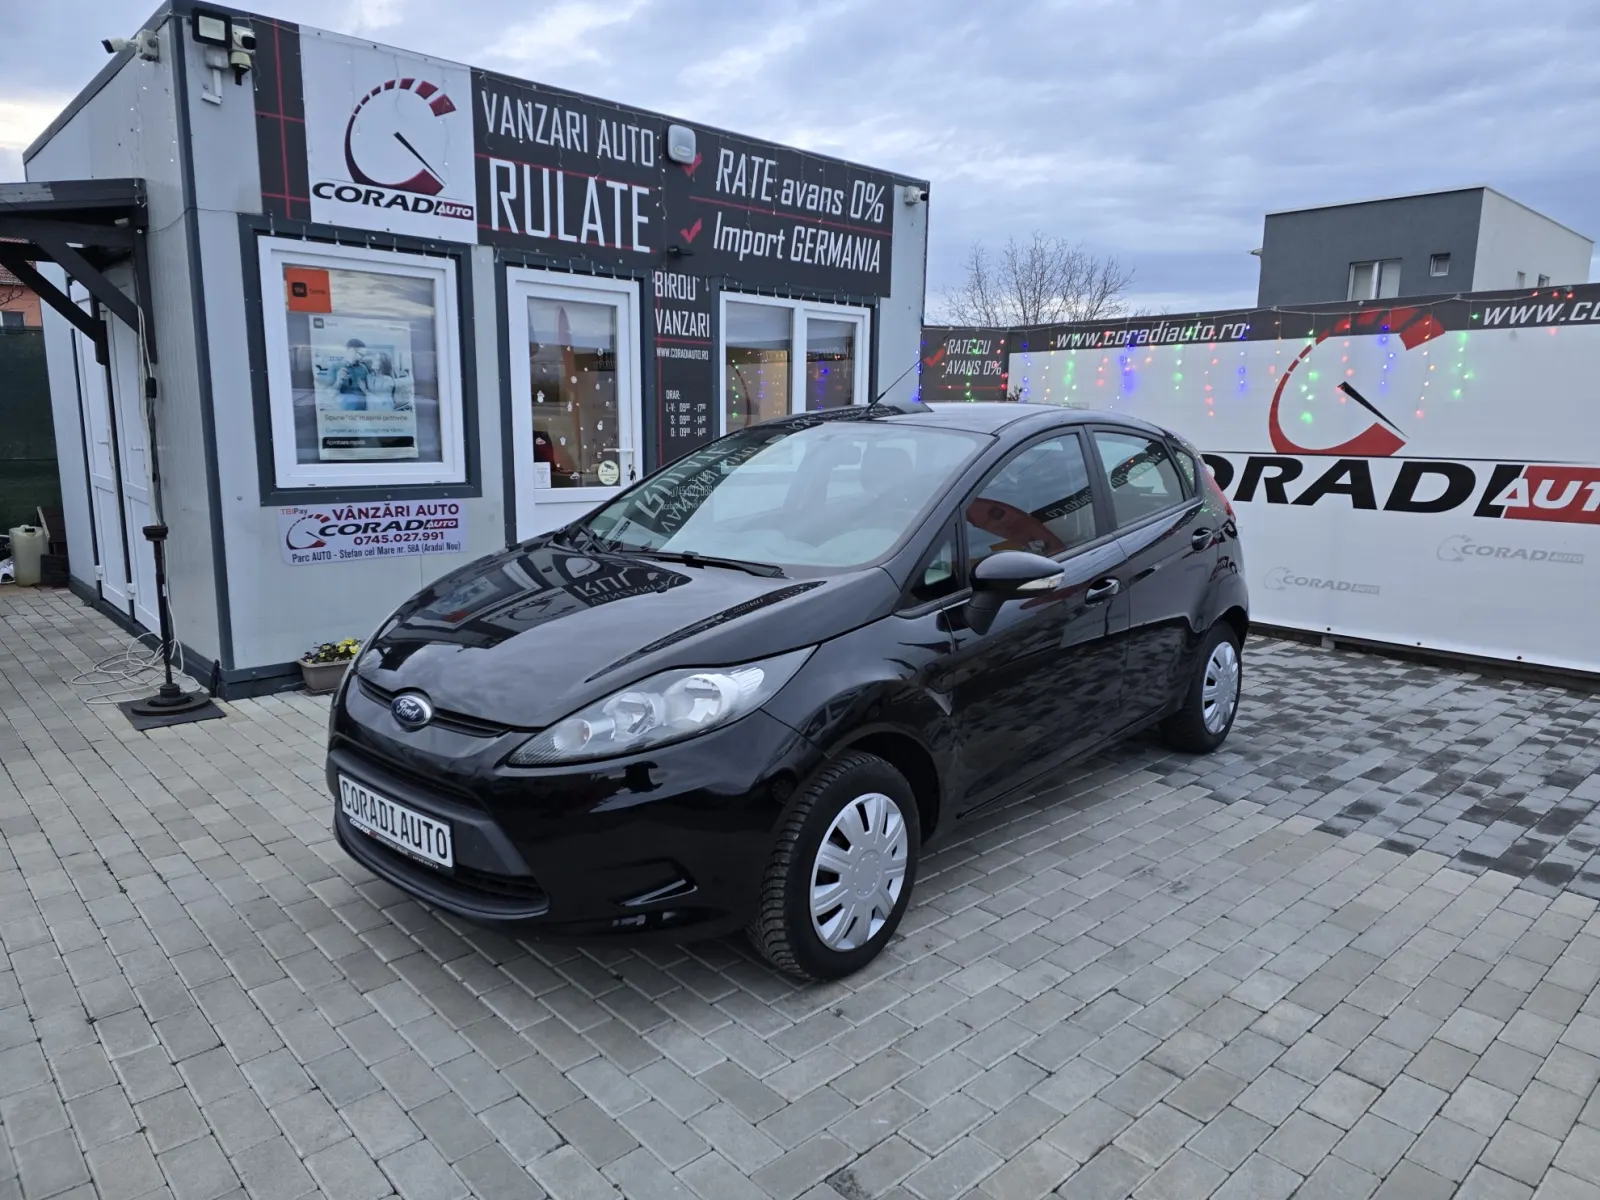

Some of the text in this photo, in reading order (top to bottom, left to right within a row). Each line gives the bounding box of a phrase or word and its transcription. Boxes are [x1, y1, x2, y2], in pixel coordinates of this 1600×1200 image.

[481, 90, 655, 168] VANZARI AUTO
[716, 148, 885, 223] RATE avans 0%
[436, 204, 473, 218] AUTO
[489, 157, 651, 253] RULATE
[713, 211, 881, 274] Import GERMANIA
[654, 271, 697, 301] BIROU
[654, 308, 711, 338] VANZARI
[1056, 320, 1246, 349] www.coradiauto.ro
[656, 347, 709, 360] WWW.CORADIAUTO.RO
[946, 338, 992, 356] RATE CU
[945, 359, 1002, 376] AVANS 0%
[1200, 454, 1525, 519] RADI
[332, 503, 459, 521] VÂNZĂRI AUTO
[426, 520, 457, 529] AUTO
[353, 531, 444, 546] 0745.027.991
[292, 553, 310, 563] Parc
[312, 550, 332, 561] AUTO
[364, 547, 375, 556] cel
[376, 546, 396, 556] Mare
[395, 698, 420, 720] Ford
[341, 780, 398, 838] CORADI
[400, 811, 449, 860] AUTO
